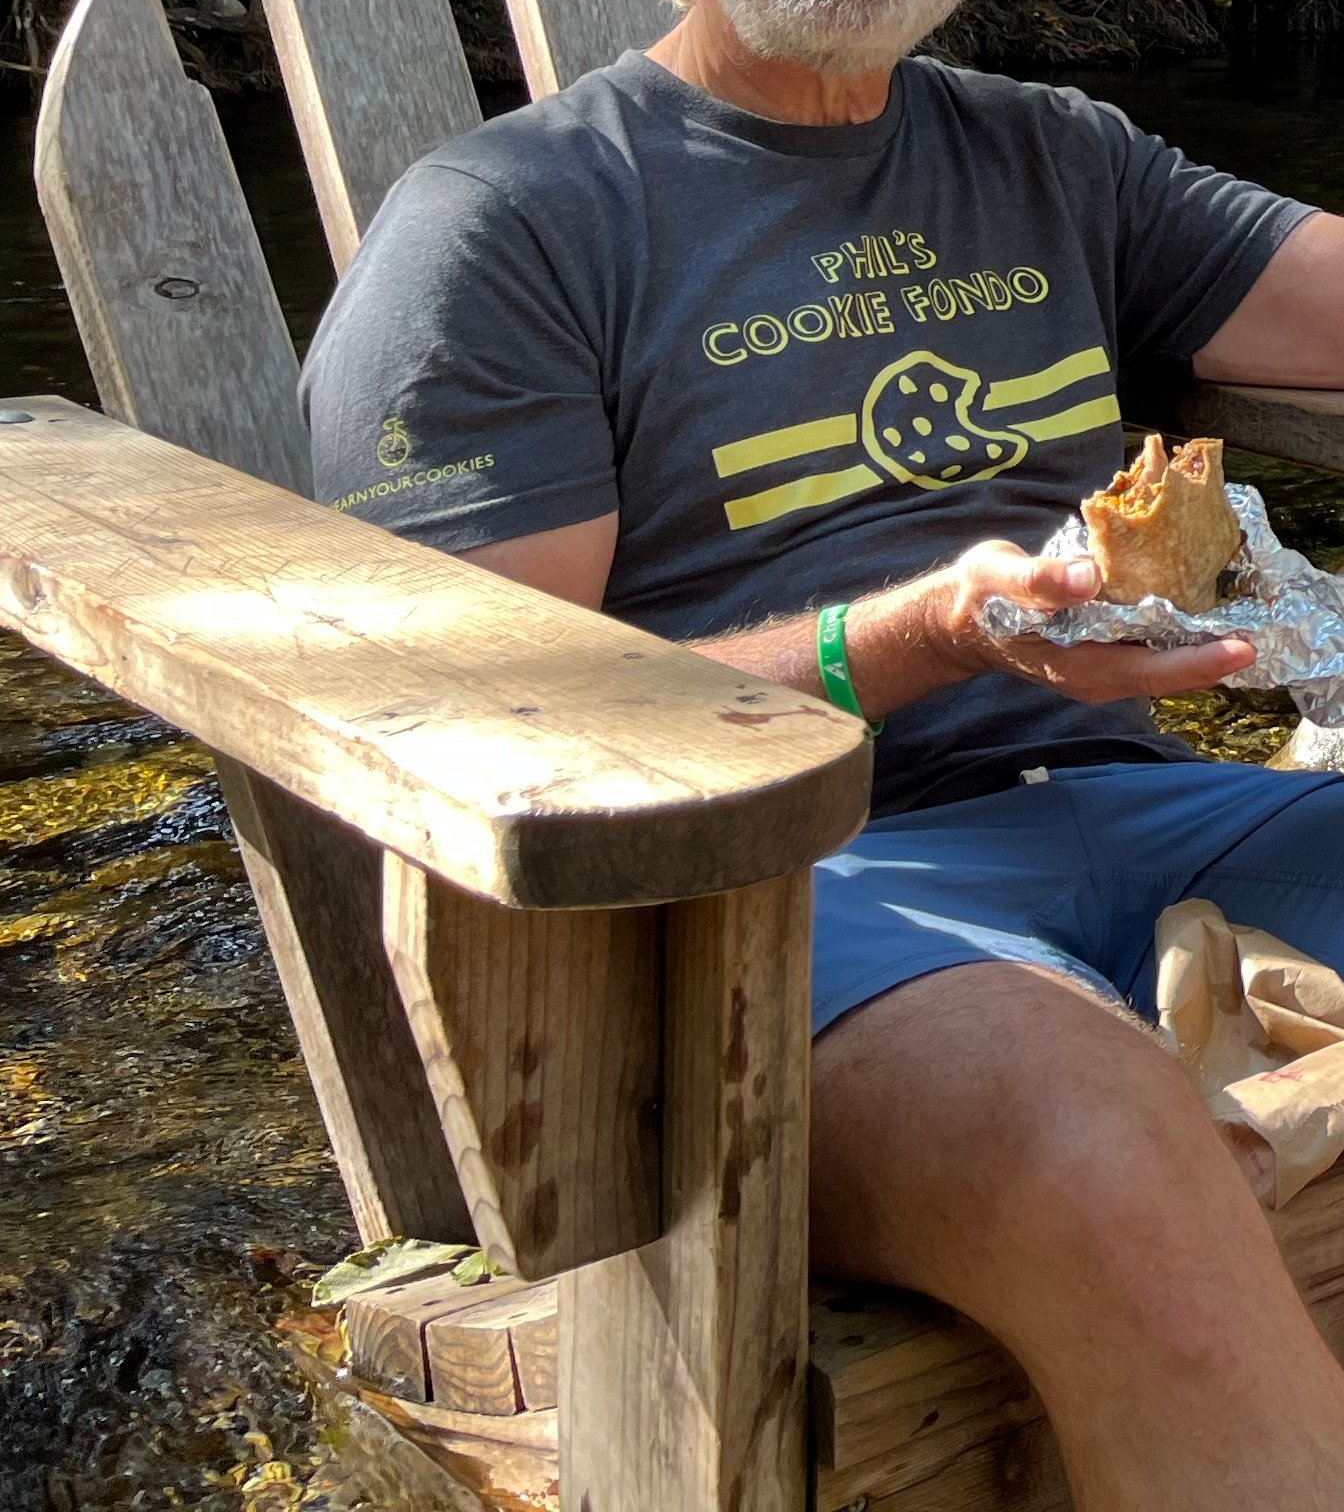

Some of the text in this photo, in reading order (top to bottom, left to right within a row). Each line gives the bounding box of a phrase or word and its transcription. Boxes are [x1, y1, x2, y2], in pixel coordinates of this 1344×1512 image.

[810, 230, 937, 284] PHIL'S
[702, 266, 1050, 366] COOKIE FONDO
